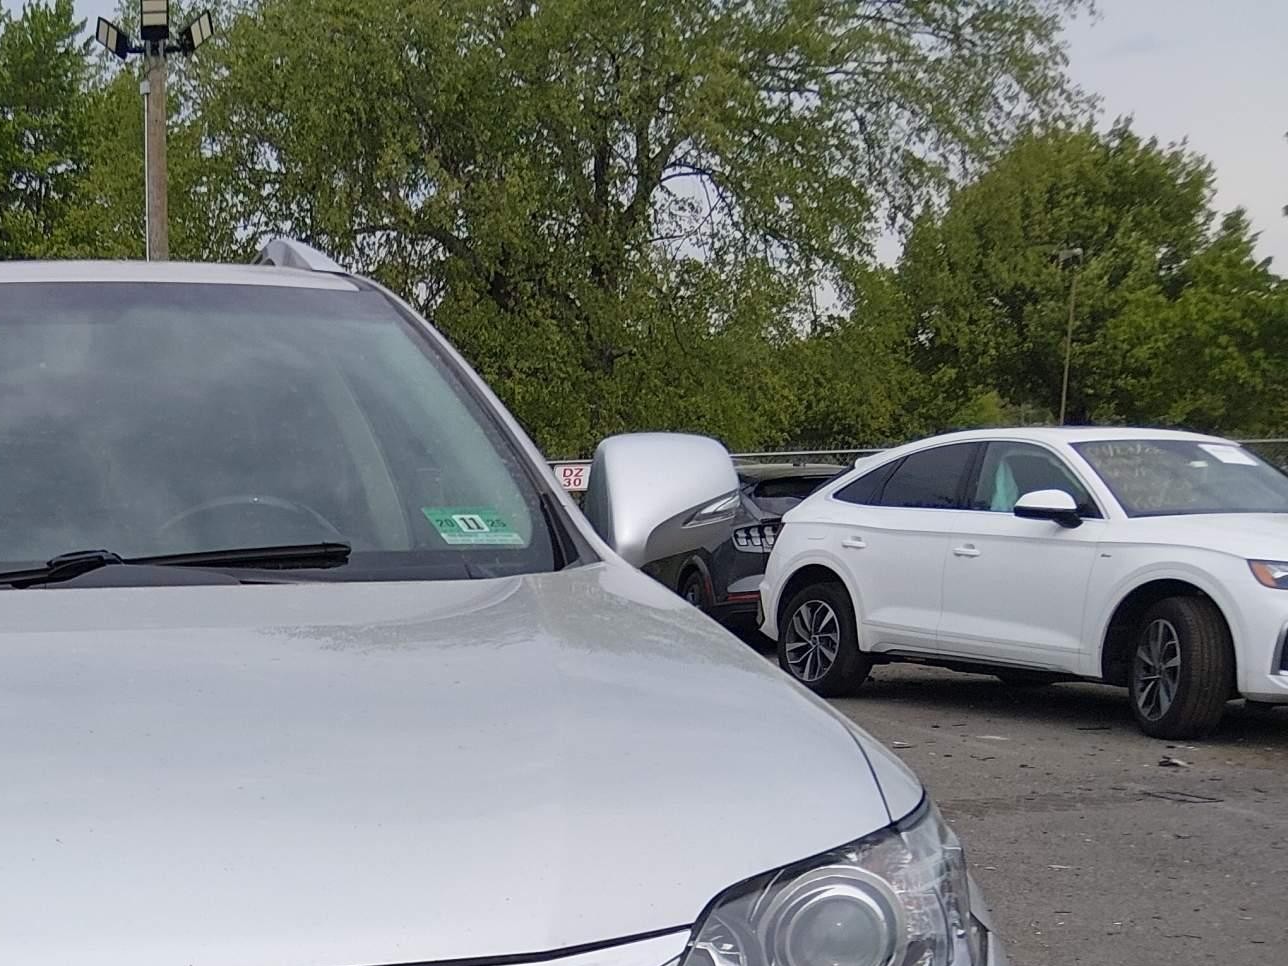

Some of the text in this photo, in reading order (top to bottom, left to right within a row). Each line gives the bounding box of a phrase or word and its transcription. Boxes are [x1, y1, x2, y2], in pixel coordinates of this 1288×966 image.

[563, 468, 584, 478] DZ
[563, 478, 582, 487] 30
[459, 517, 485, 530] 11
